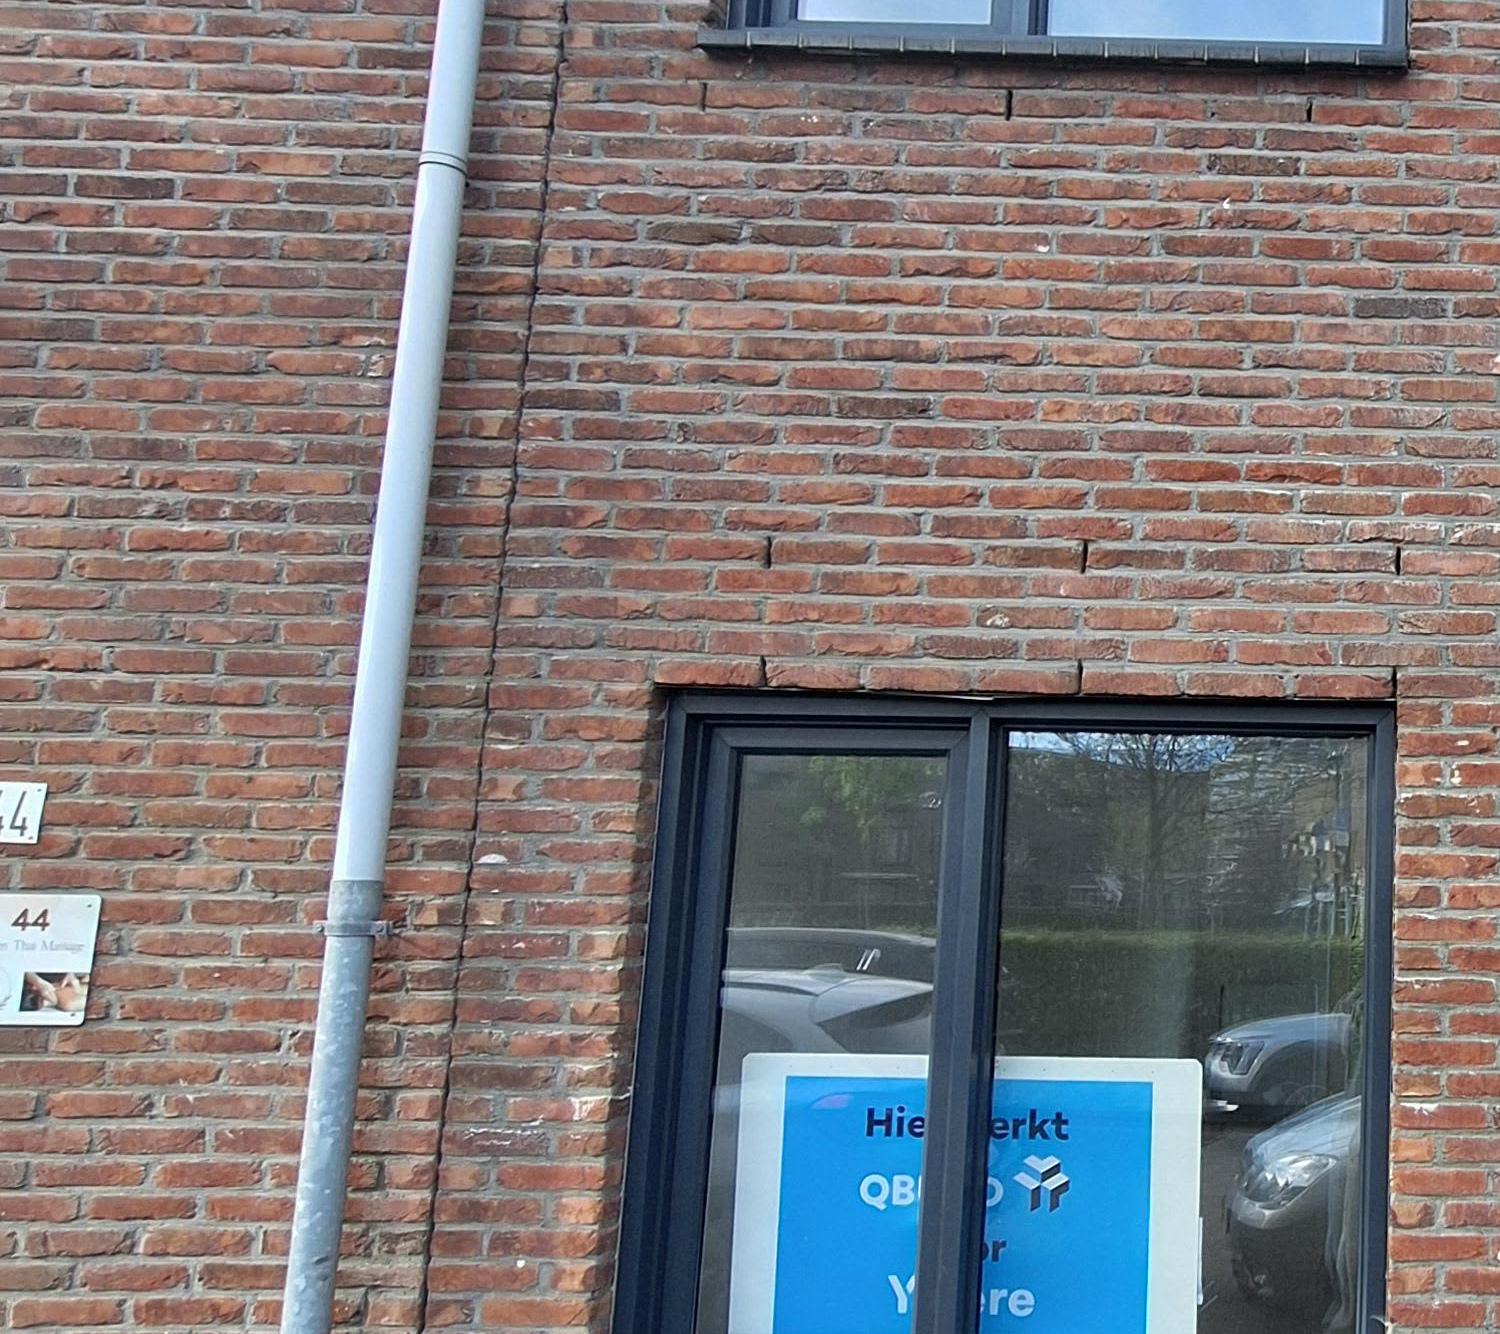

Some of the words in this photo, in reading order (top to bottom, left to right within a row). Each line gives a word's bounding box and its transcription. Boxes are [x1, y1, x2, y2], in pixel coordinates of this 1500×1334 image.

[0, 790, 27, 837] 4
[11, 907, 50, 931] 44
[866, 1106, 926, 1138] Hie
[988, 1108, 1070, 1141] erkt
